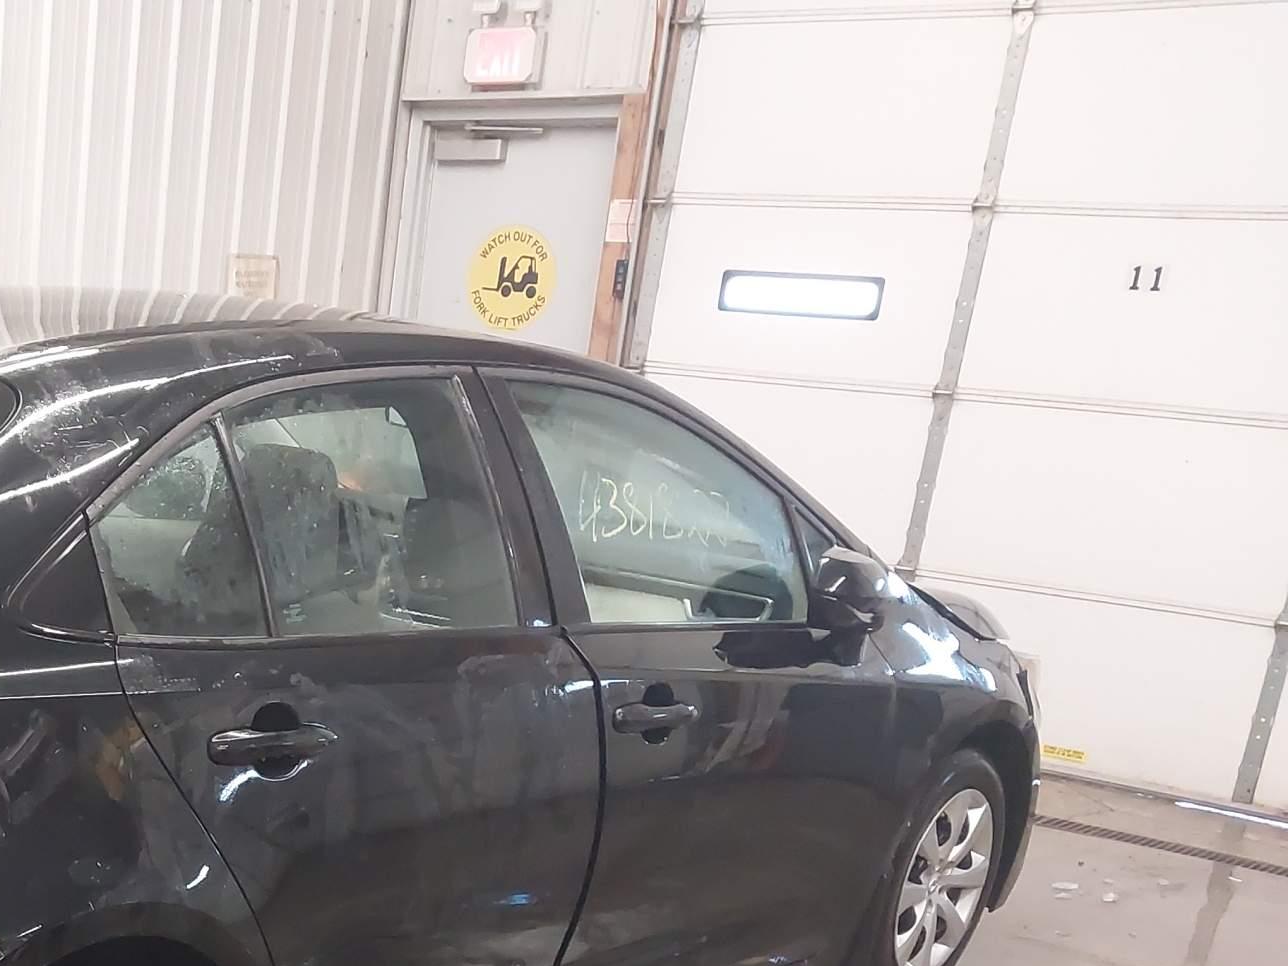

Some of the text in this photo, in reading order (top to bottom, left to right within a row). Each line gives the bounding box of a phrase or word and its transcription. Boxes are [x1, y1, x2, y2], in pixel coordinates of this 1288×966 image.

[480, 231, 548, 262] WATCH OUT FOR
[472, 290, 546, 327] FORK LIFT TRUCKS
